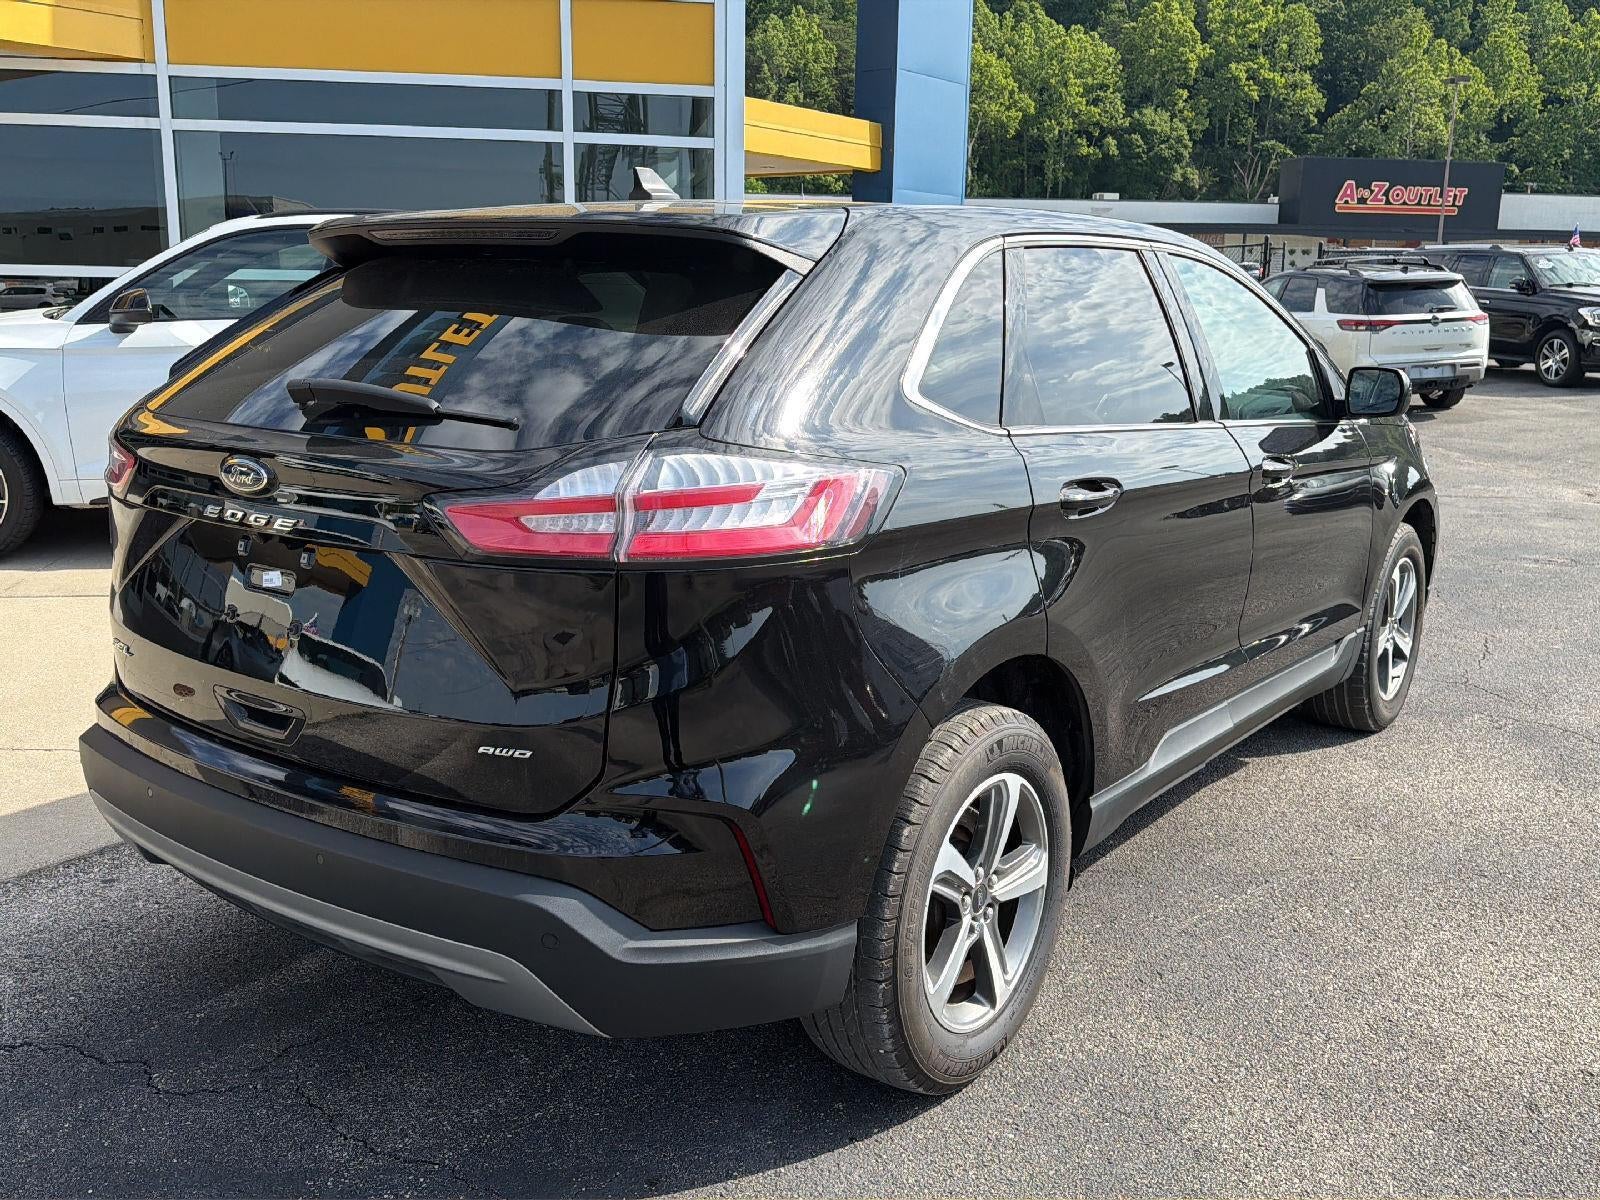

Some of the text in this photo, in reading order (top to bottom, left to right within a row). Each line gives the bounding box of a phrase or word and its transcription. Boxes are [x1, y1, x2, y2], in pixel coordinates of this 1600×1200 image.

[1389, 185, 1468, 206] OUTLET
[1391, 325, 1474, 336] PATHFINDER
[228, 465, 255, 485] Ford
[203, 504, 299, 532] EDGE
[477, 746, 533, 759] AWD
